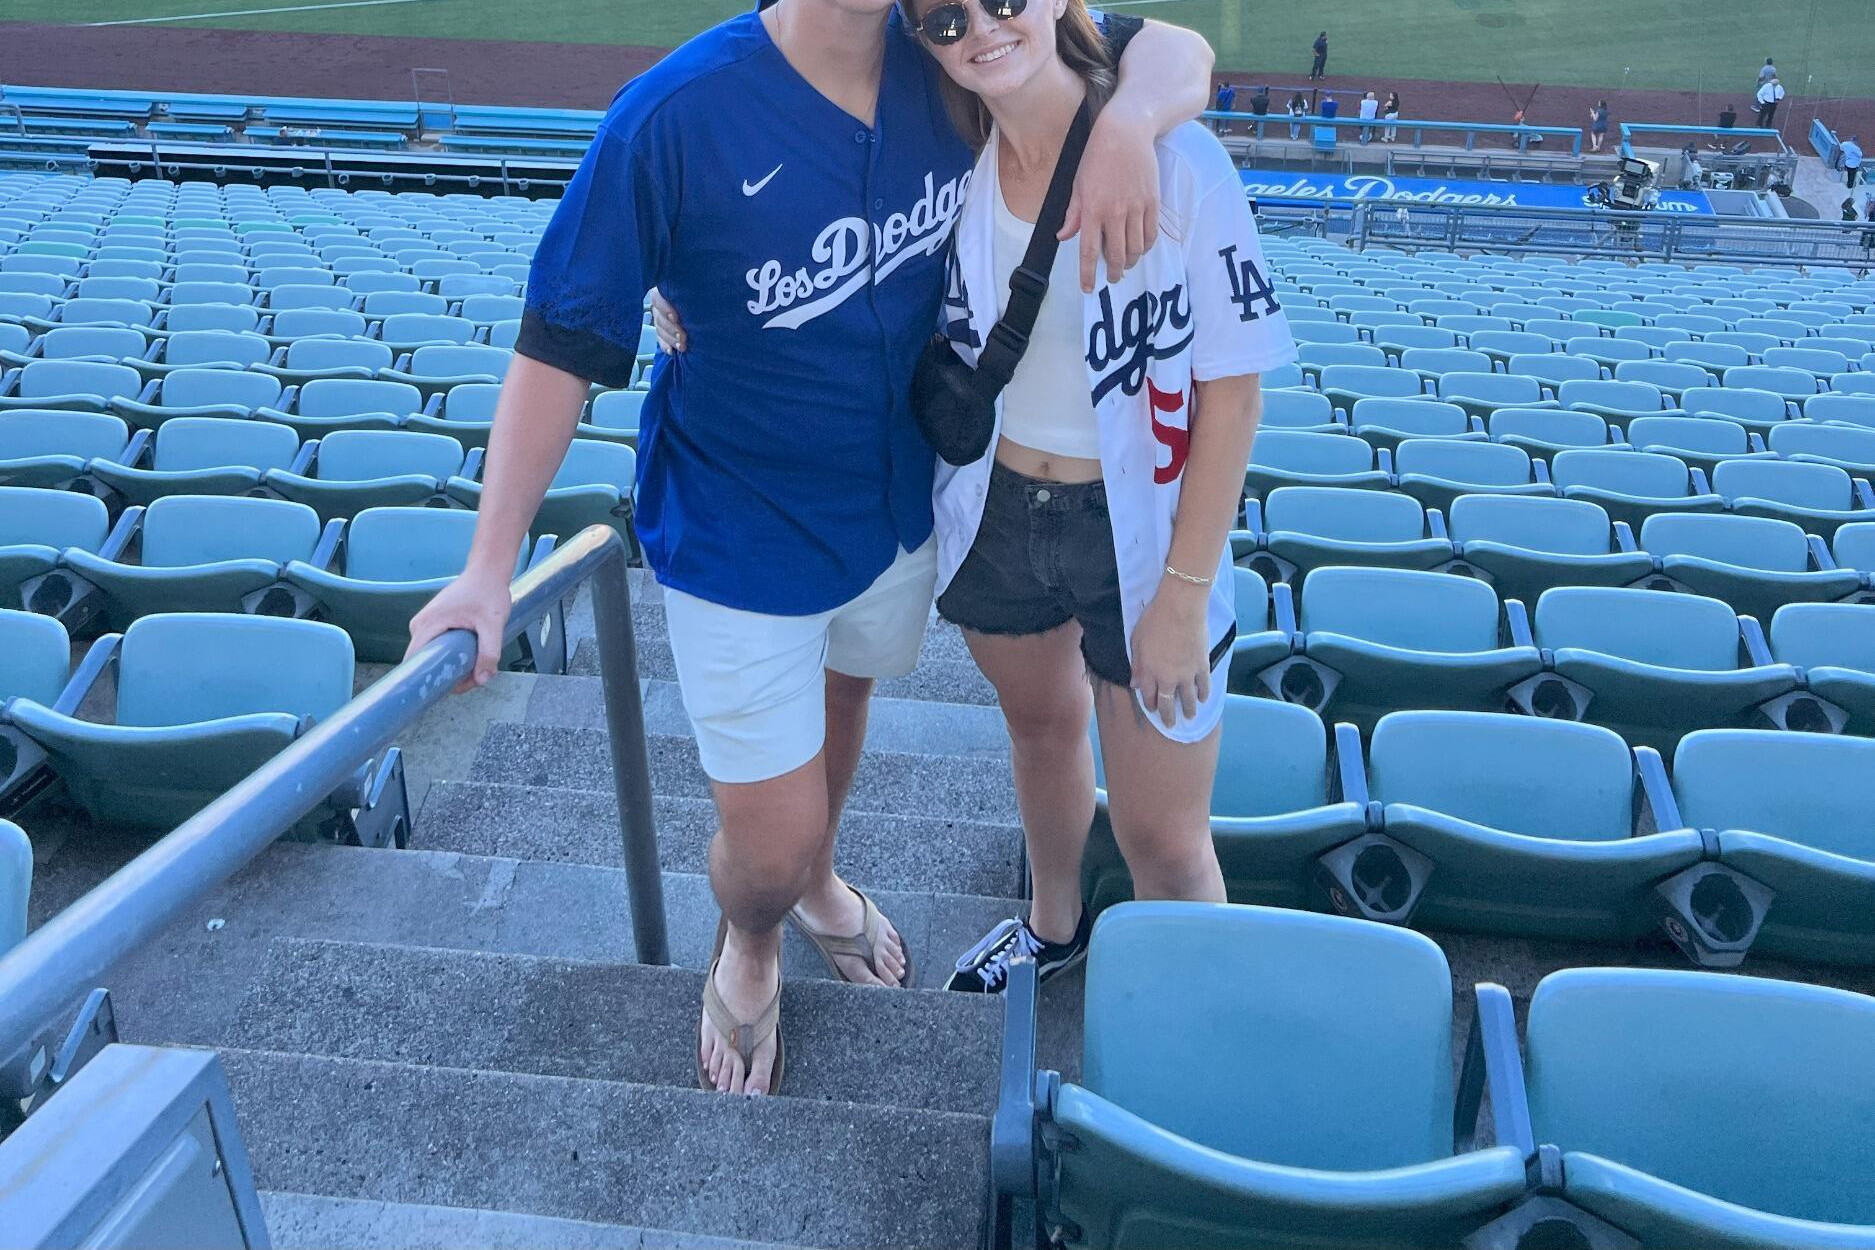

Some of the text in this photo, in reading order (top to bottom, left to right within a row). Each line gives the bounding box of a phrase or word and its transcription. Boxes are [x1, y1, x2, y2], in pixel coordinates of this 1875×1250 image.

[745, 168, 973, 316] Los Dodge
[1217, 243, 1282, 323] LA
